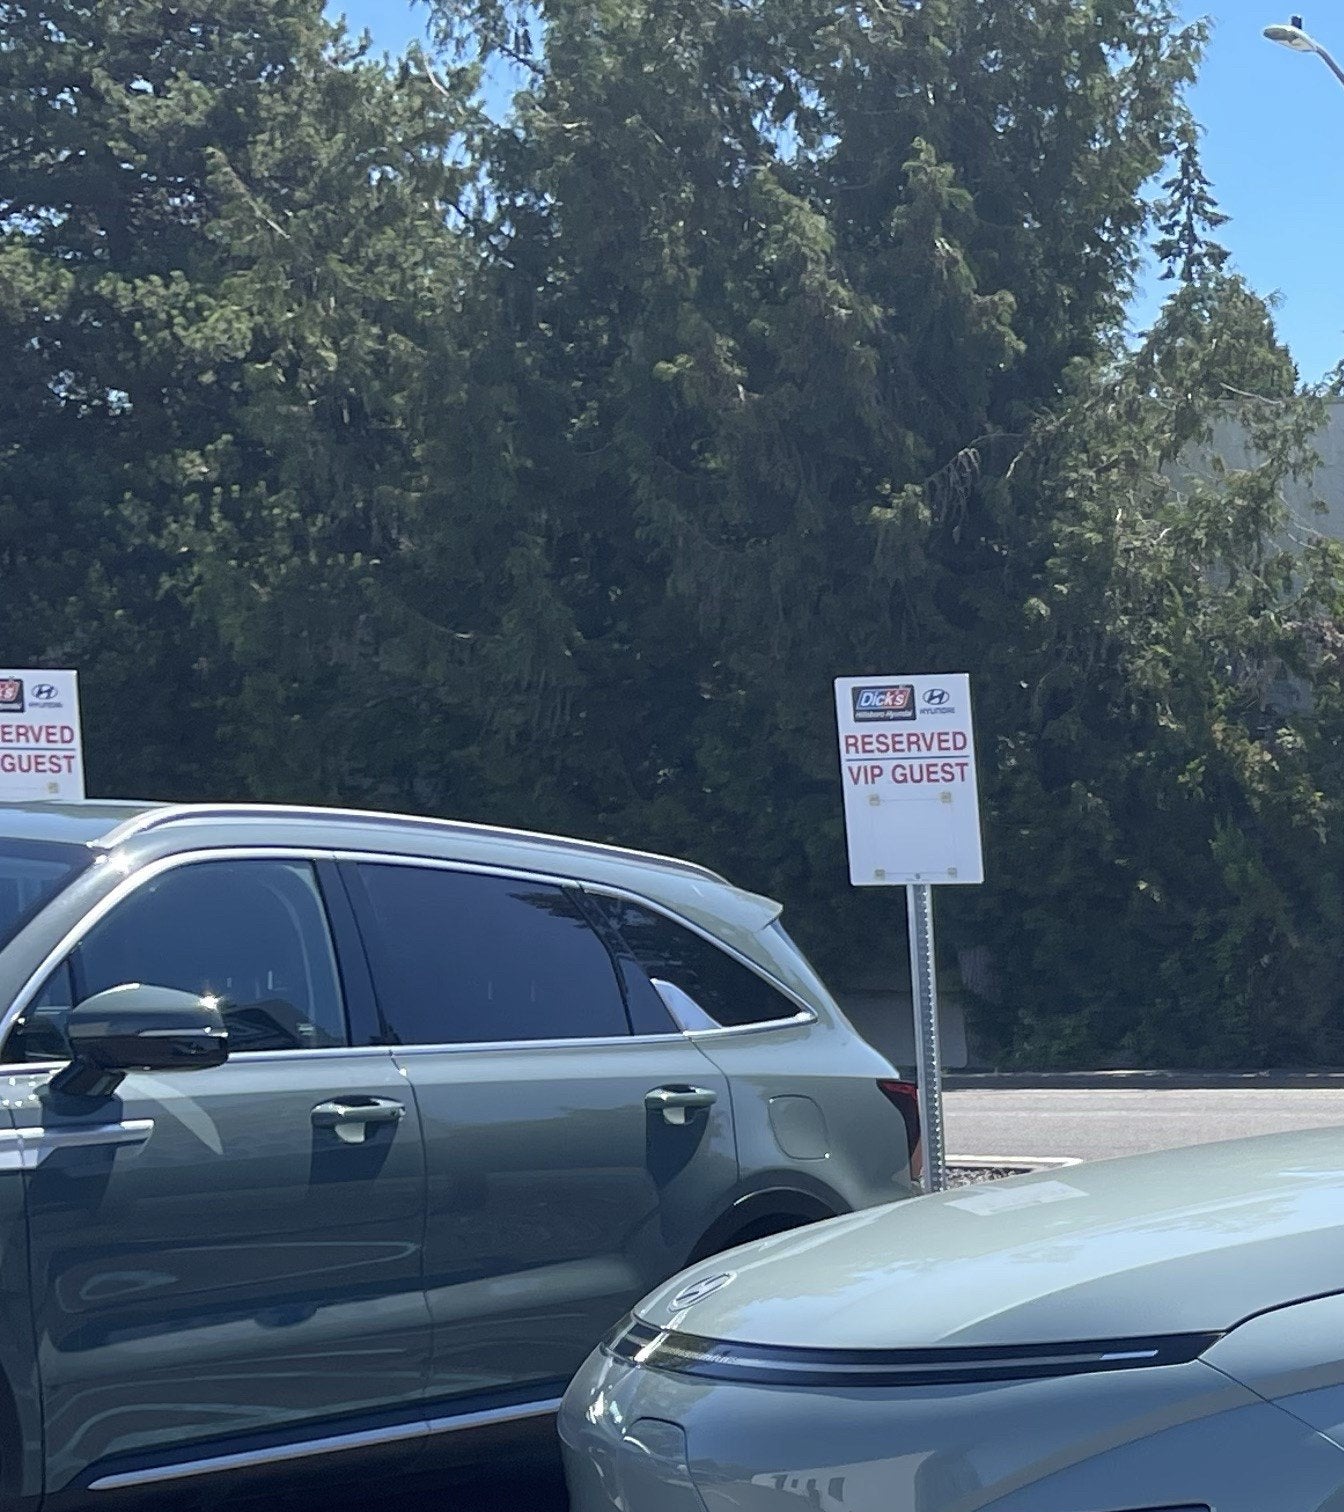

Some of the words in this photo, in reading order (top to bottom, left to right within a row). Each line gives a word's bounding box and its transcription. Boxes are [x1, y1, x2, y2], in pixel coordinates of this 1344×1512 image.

[0, 724, 75, 744] ERVED
[844, 731, 968, 754] RESERVED
[1, 753, 75, 774] GUEST
[847, 764, 884, 785] VIP
[891, 762, 969, 784] GUEST
